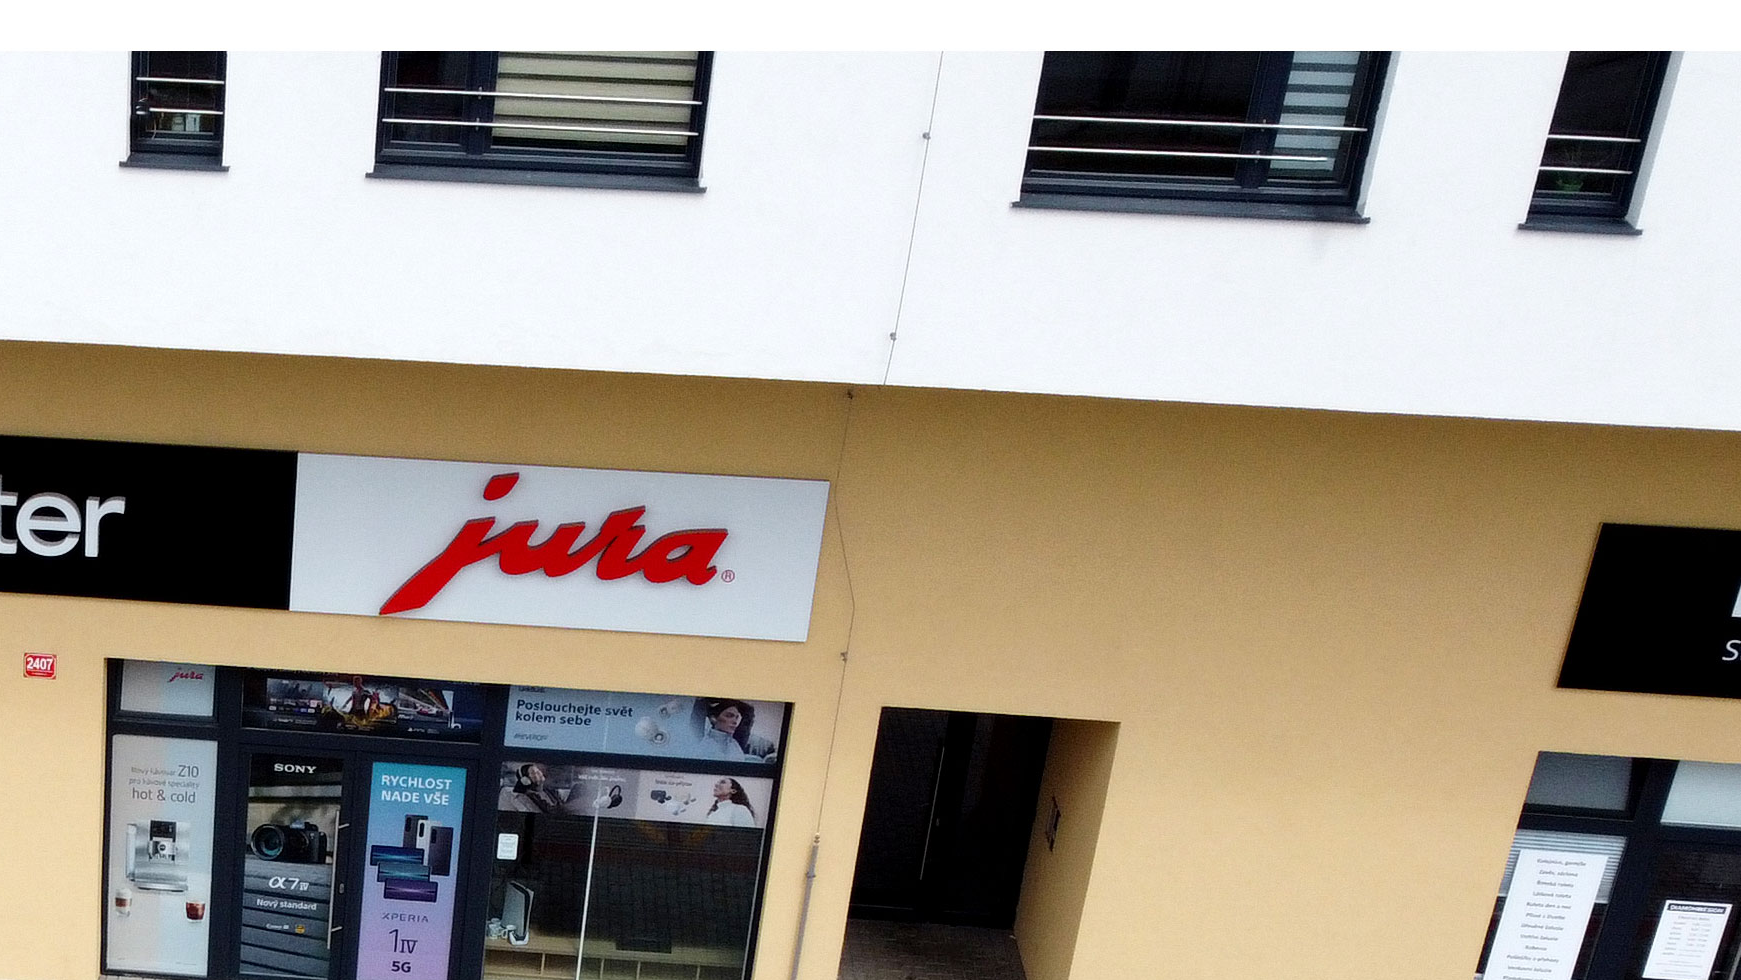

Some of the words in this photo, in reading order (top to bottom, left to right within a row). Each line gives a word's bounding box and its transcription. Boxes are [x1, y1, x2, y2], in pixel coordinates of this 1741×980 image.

[26, 656, 54, 671] 2407
[167, 667, 204, 682] jura
[516, 699, 602, 717] Poslouchejte
[605, 706, 633, 718] svět
[515, 711, 556, 724] kolem
[559, 714, 592, 726] sebe
[177, 764, 200, 778] Z10
[273, 763, 317, 774] SONY
[381, 774, 453, 790] RYCHLOST
[132, 787, 153, 800] hot
[156, 789, 166, 801] &
[170, 791, 196, 804] cold
[381, 789, 420, 803] NADE
[423, 791, 450, 806] VŠE
[256, 898, 279, 910] Nový
[279, 899, 317, 911] standard
[381, 912, 429, 923] XPERIA
[391, 961, 412, 973] 5G
